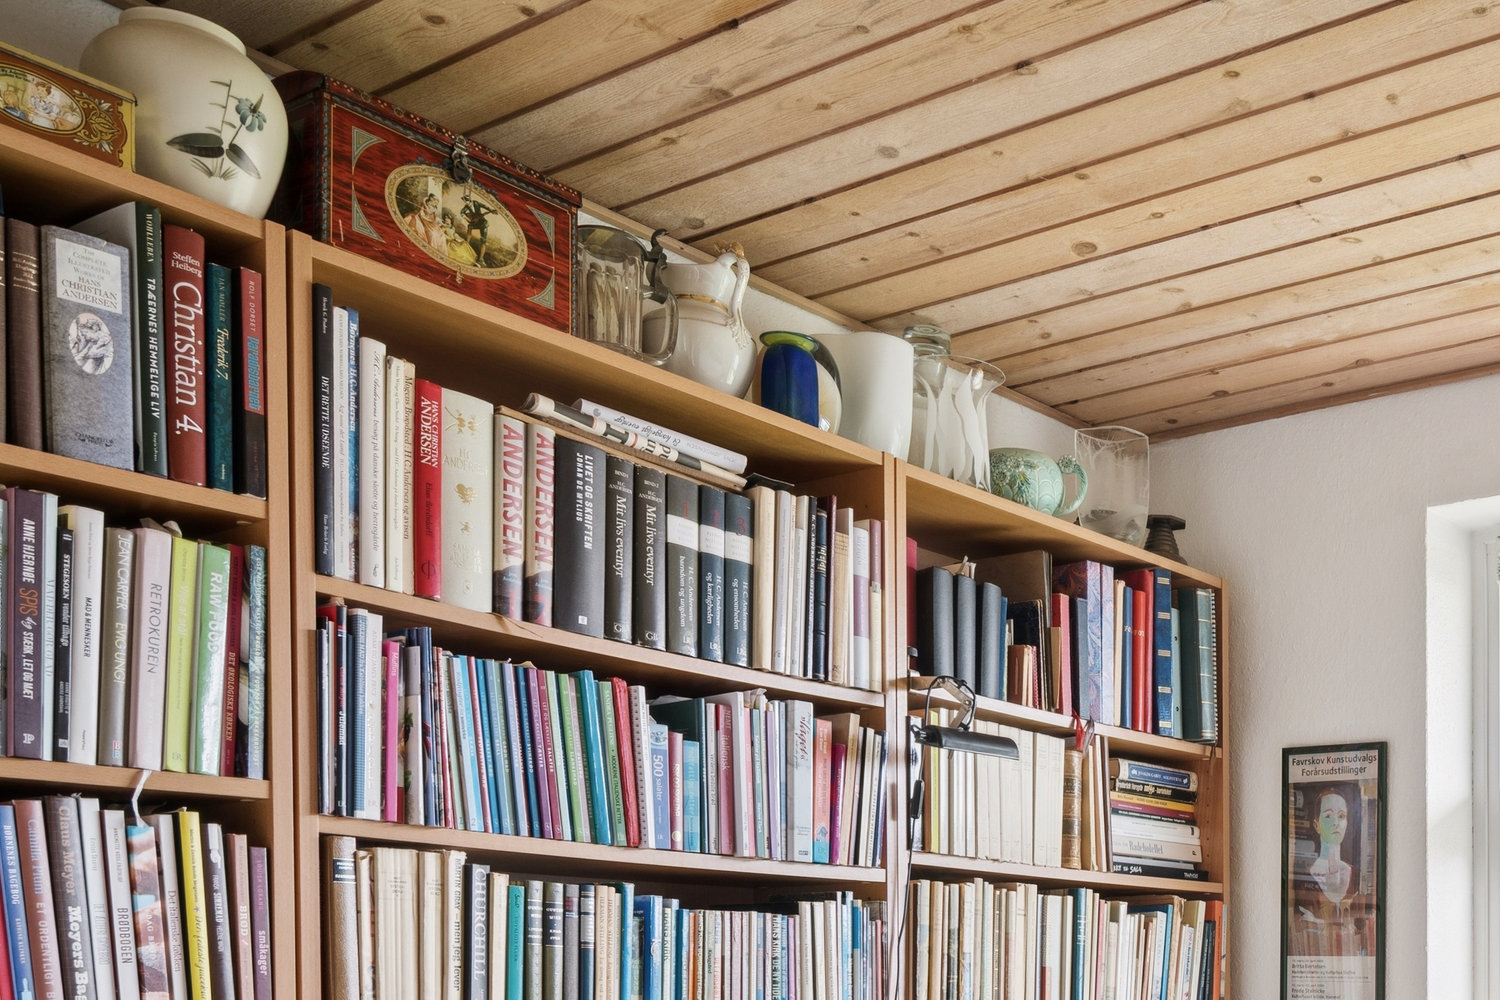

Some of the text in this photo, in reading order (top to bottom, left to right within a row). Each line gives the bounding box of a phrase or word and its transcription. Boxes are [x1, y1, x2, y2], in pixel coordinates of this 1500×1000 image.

[172, 259, 202, 277] Heiberg
[173, 252, 201, 266] Steffen
[147, 278, 160, 419] TRÆERNES HEMMELIGE LIV
[173, 281, 203, 435] Christian 4.
[216, 328, 228, 379] Frederik 7.
[321, 376, 330, 468] DET RETTE UDSEENDE
[420, 397, 431, 465] ANDERSEN
[431, 425, 439, 468] CHRISTIAN
[503, 424, 523, 560] ANDERSEN
[536, 432, 555, 563] ANDERSEN
[584, 455, 593, 549] LIVET OG SKRIFTEN
[613, 495, 626, 578] Mit livs eventyr
[644, 504, 657, 586] Mit livs eventyr
[113, 535, 129, 683] JEAN CARPER EVIG UNG!
[147, 583, 162, 673] RETROKUREN
[226, 668, 235, 710] ØKOLOGISKE
[225, 712, 234, 741] KØKKEN
[653, 754, 663, 777] 500
[721, 735, 729, 771] italiensk
[1292, 754, 1376, 766] Favrskov Kunstudvalgs
[1301, 766, 1367, 776] Forårsudstillinger
[58, 805, 71, 847] Claus
[3, 825, 19, 905] BØRNENES BAGEBOG
[61, 851, 75, 896] Meyer
[67, 905, 89, 968] Meyers
[117, 907, 132, 964] BRØDBOGEN
[168, 890, 182, 972] Det italienske køkken
[239, 904, 248, 936] BRØD
[453, 921, 461, 943] men
[473, 868, 486, 980] CHURCHILL
[772, 917, 780, 939] HANS
[257, 930, 269, 976] småkager
[452, 945, 461, 962] jeg
[772, 940, 780, 958] KIRK
[772, 959, 780, 969] DE
[453, 964, 462, 991] lever
[772, 971, 780, 982] NY
